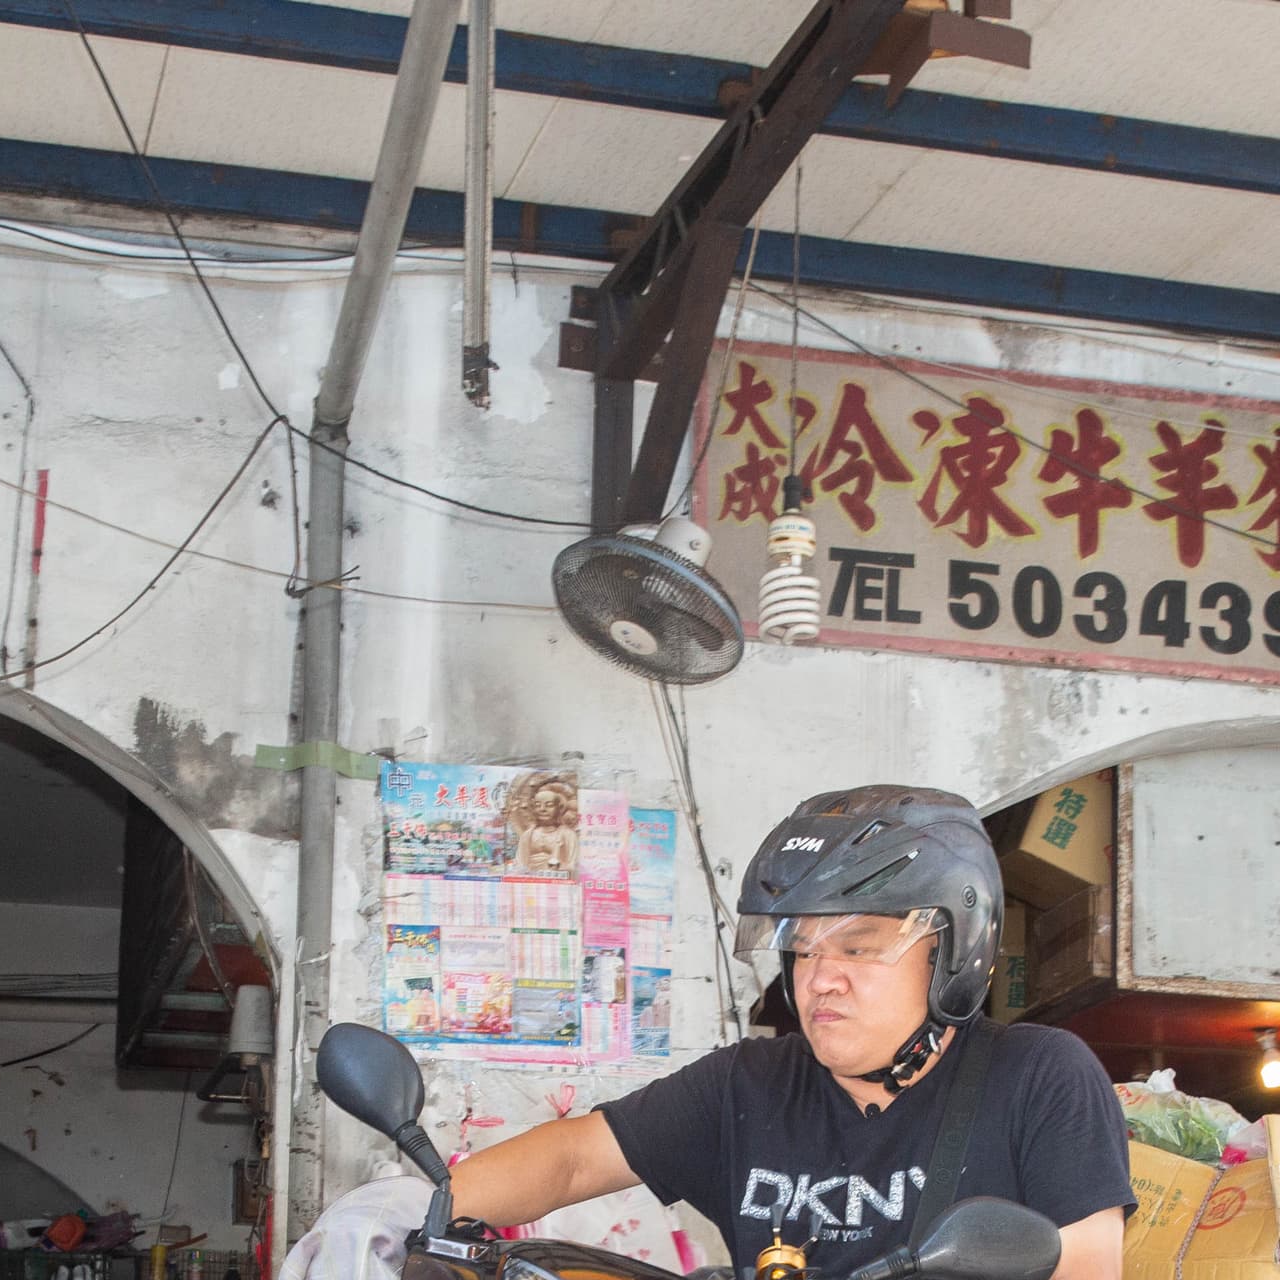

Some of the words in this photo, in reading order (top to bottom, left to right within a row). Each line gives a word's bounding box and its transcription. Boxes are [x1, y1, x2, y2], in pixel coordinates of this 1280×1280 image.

[719, 360, 788, 522] 大成
[827, 547, 922, 624] TEL
[781, 836, 825, 853] SYM
